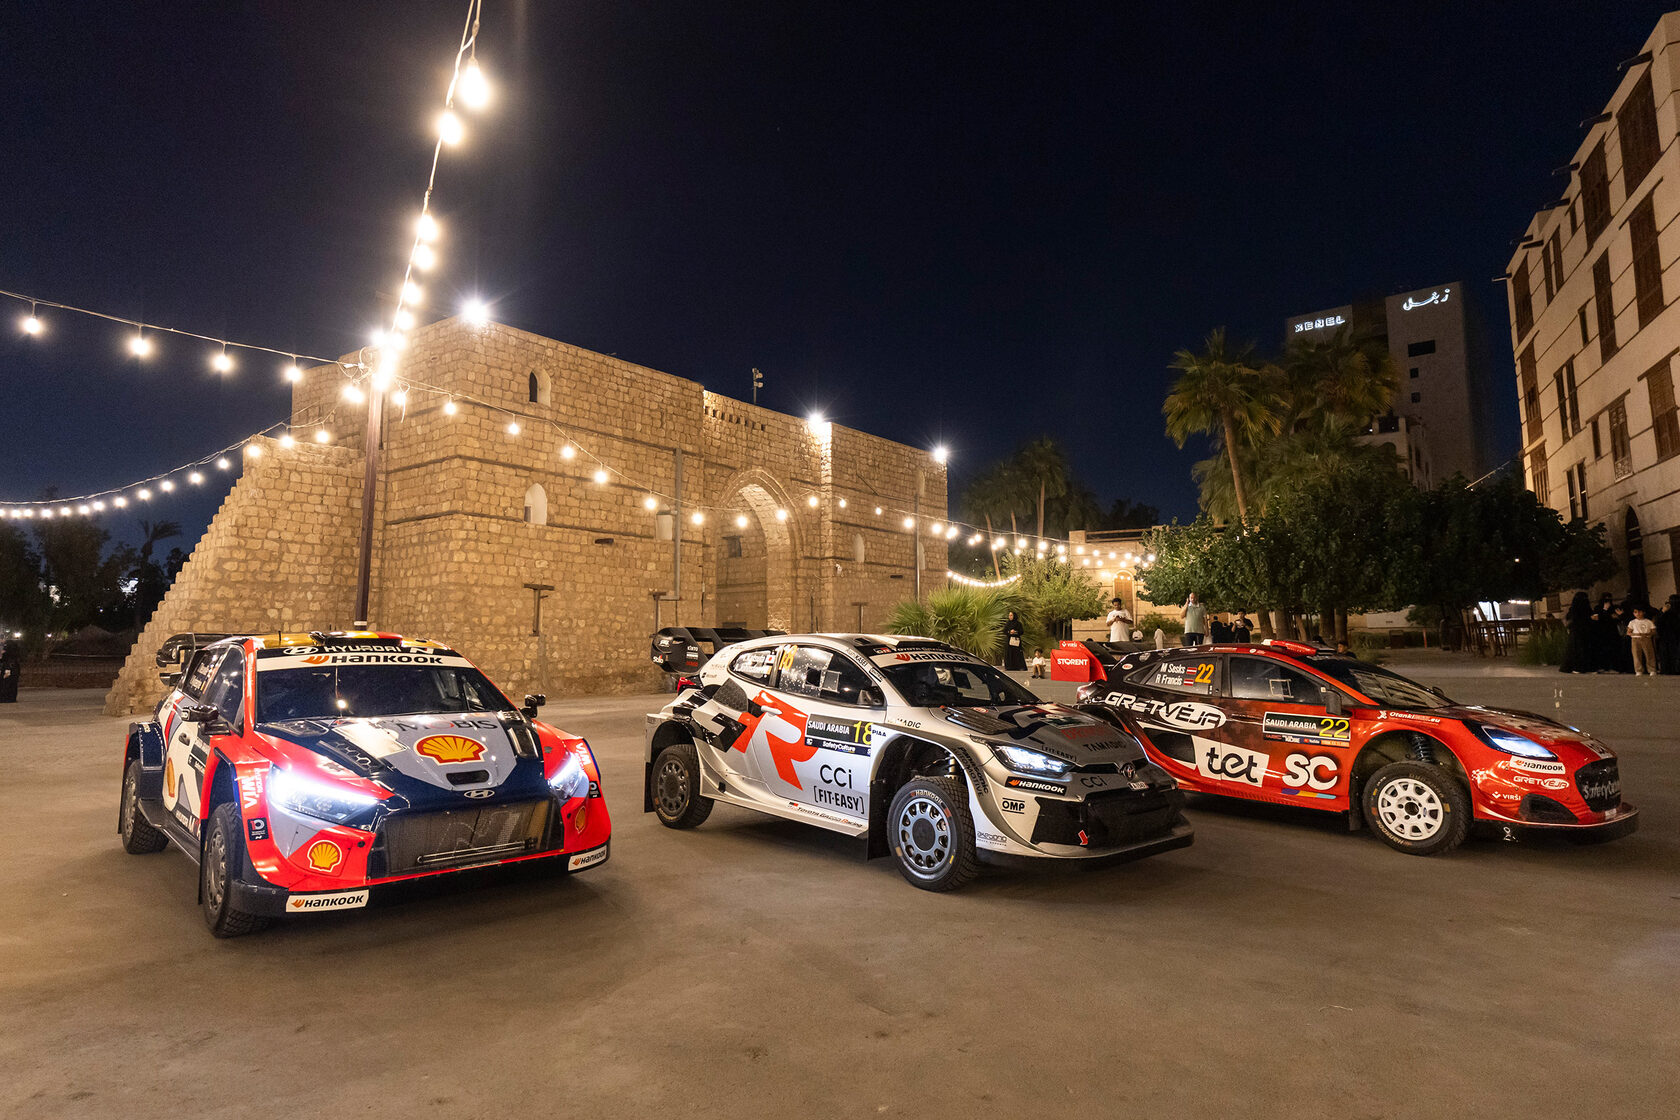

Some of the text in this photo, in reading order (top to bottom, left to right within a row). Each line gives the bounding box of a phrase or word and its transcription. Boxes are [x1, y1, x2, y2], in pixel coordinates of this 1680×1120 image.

[1294, 315, 1346, 333] XENEL
[324, 645, 402, 653] HYUNDAI
[1194, 663, 1215, 684] 22
[808, 720, 850, 735] SAUDI ARABIA
[853, 720, 871, 746] 18
[1265, 718, 1317, 730] SAUDI ARABIA
[1319, 718, 1349, 739] 22
[1206, 747, 1258, 783] tet
[1282, 753, 1338, 790] SC
[1002, 801, 1025, 811] OMP
